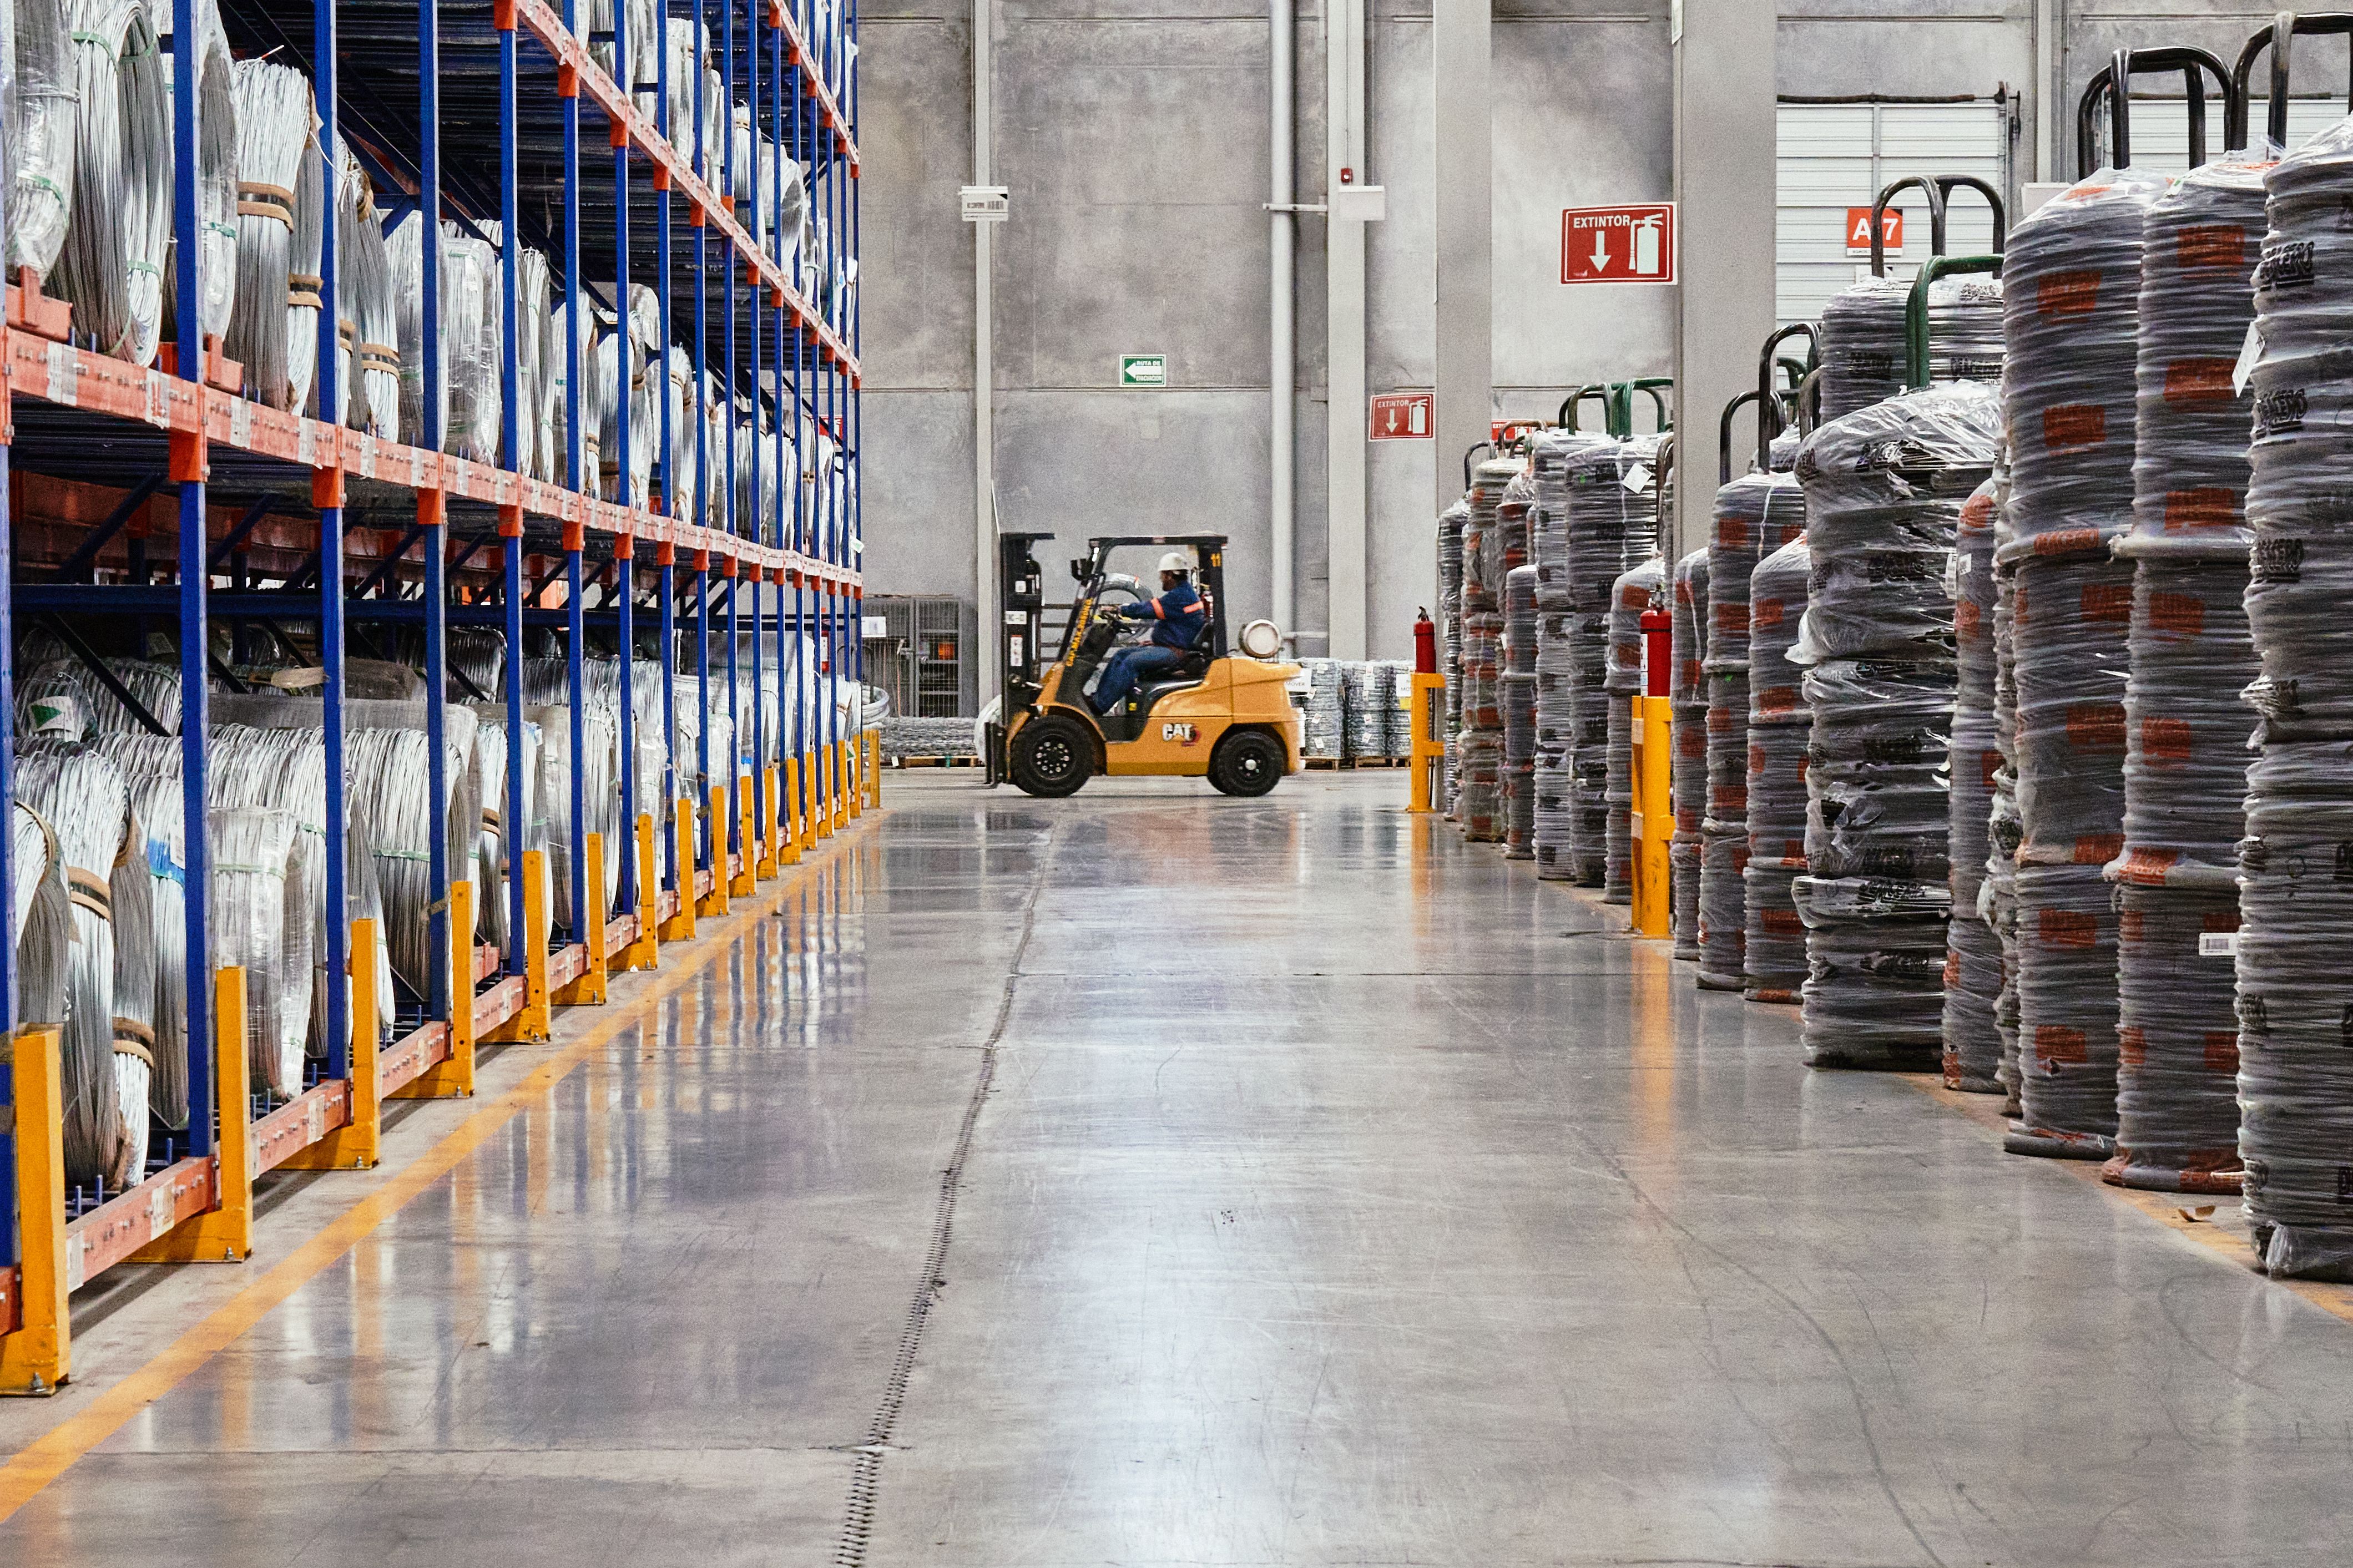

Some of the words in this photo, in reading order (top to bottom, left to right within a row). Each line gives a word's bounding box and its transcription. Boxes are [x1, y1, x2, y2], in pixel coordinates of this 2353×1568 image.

[1573, 215, 1630, 229] EXTINTOR
[1377, 399, 1410, 408] EXTINTOR
[1162, 723, 1193, 741] CAT
